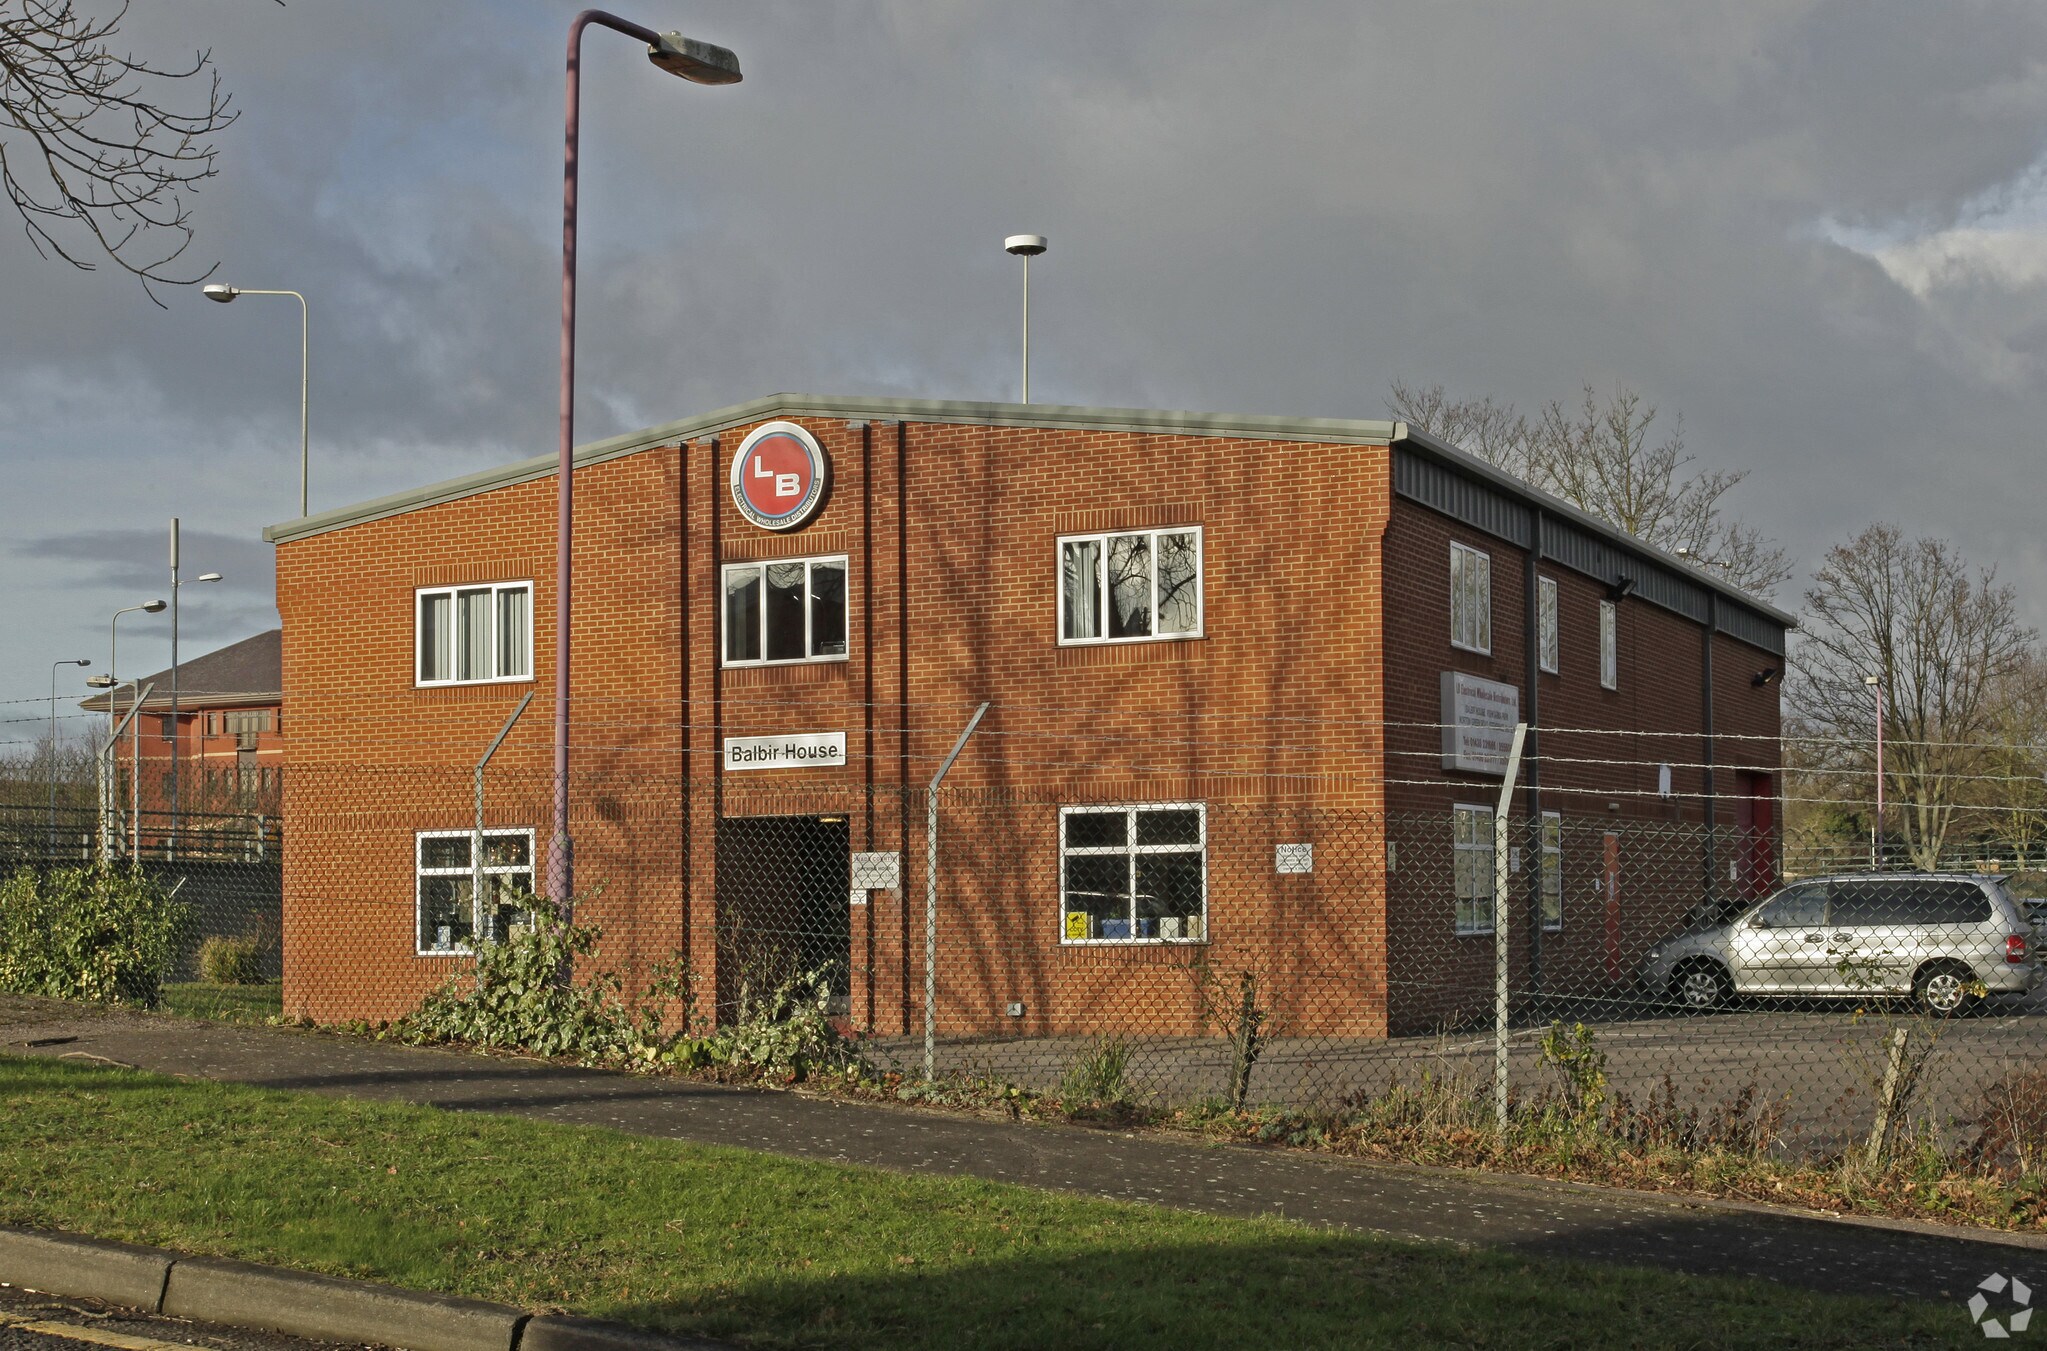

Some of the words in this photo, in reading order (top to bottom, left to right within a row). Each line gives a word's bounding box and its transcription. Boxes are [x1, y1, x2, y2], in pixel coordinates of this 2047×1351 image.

[734, 485, 756, 520] ELECTRICAL
[756, 515, 791, 527] WHOLESALE
[791, 480, 820, 521] DISTRIBUTORS
[732, 745, 779, 762] Balbir
[784, 743, 838, 760] House
